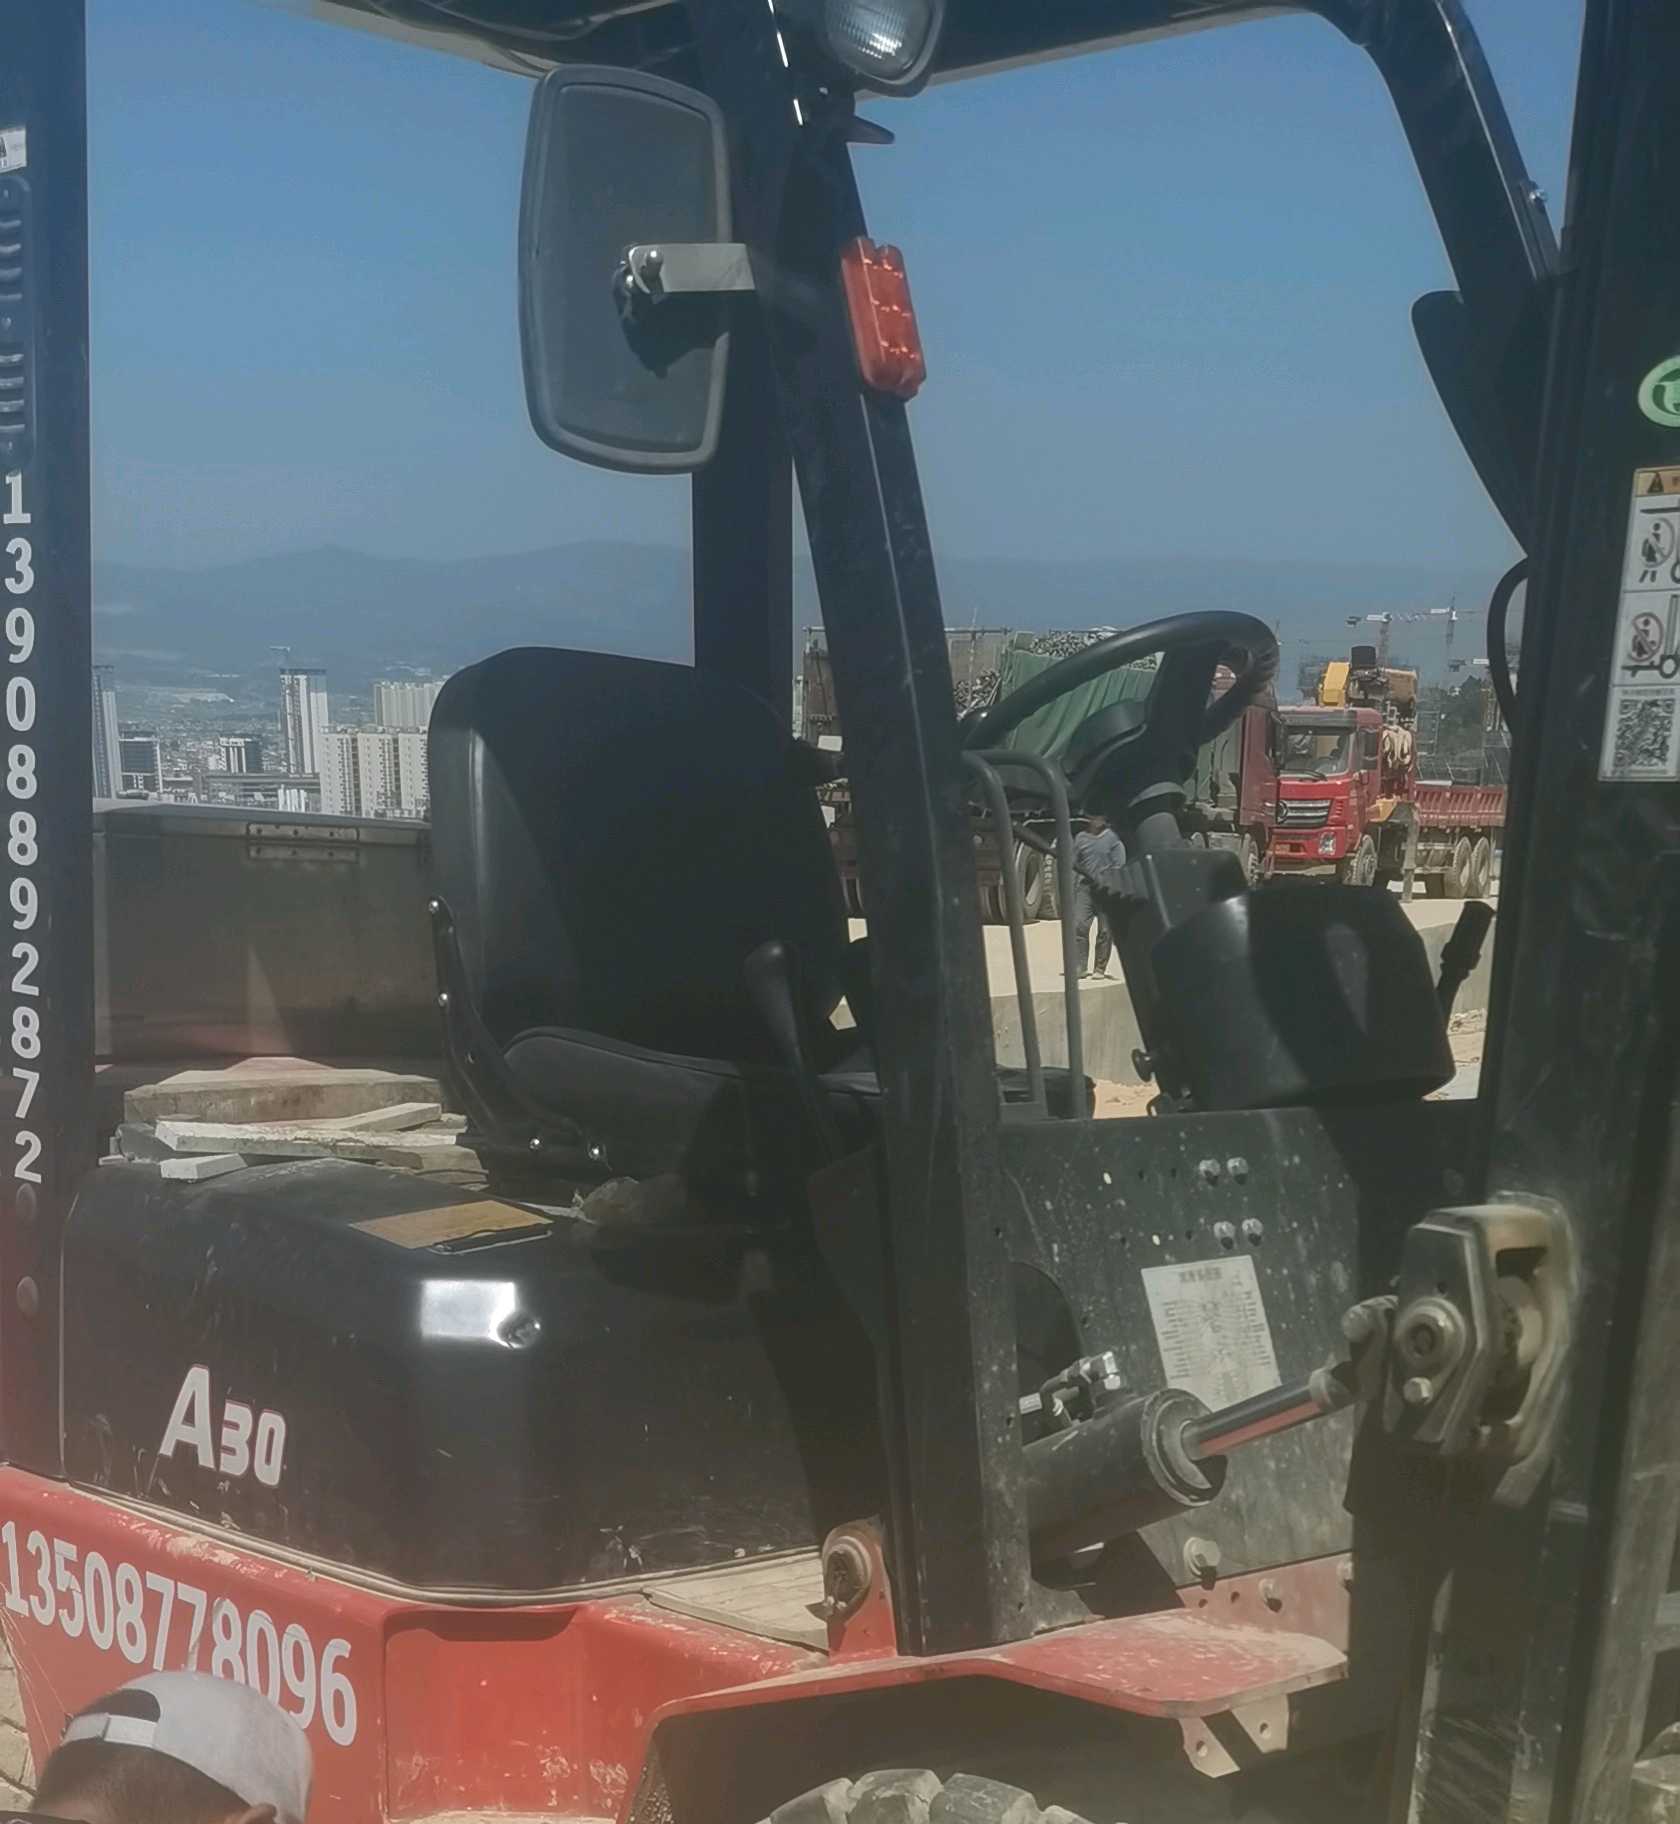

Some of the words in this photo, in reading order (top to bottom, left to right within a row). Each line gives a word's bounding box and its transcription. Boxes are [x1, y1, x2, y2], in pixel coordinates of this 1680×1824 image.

[3, 469, 42, 1184] 13908892872
[159, 1365, 286, 1486] A30
[1, 1520, 358, 1747] 13508778096
